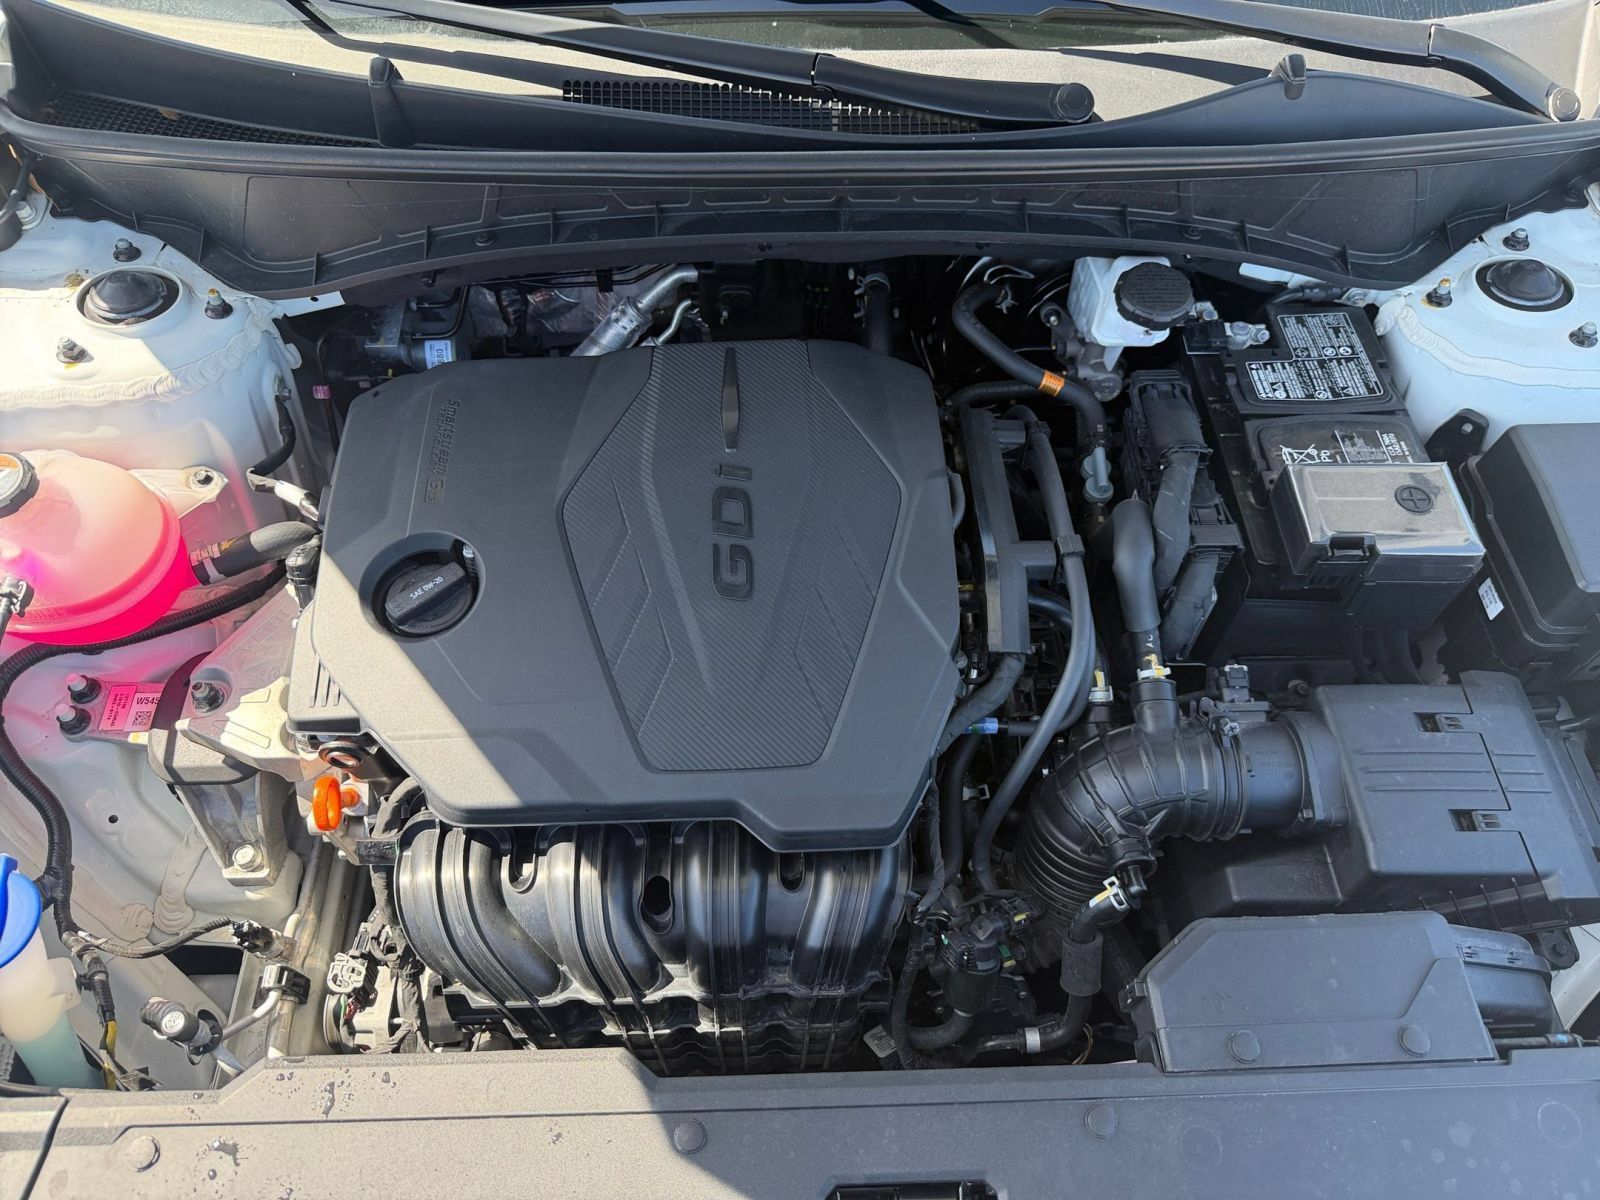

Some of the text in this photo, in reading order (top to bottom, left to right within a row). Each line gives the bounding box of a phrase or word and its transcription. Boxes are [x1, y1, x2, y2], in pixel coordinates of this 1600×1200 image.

[429, 406, 446, 475] TECHNOLOGY
[438, 397, 460, 474] Smartstream
[1320, 450, 1333, 462] Pb
[410, 576, 443, 600] SAE 0W-20
